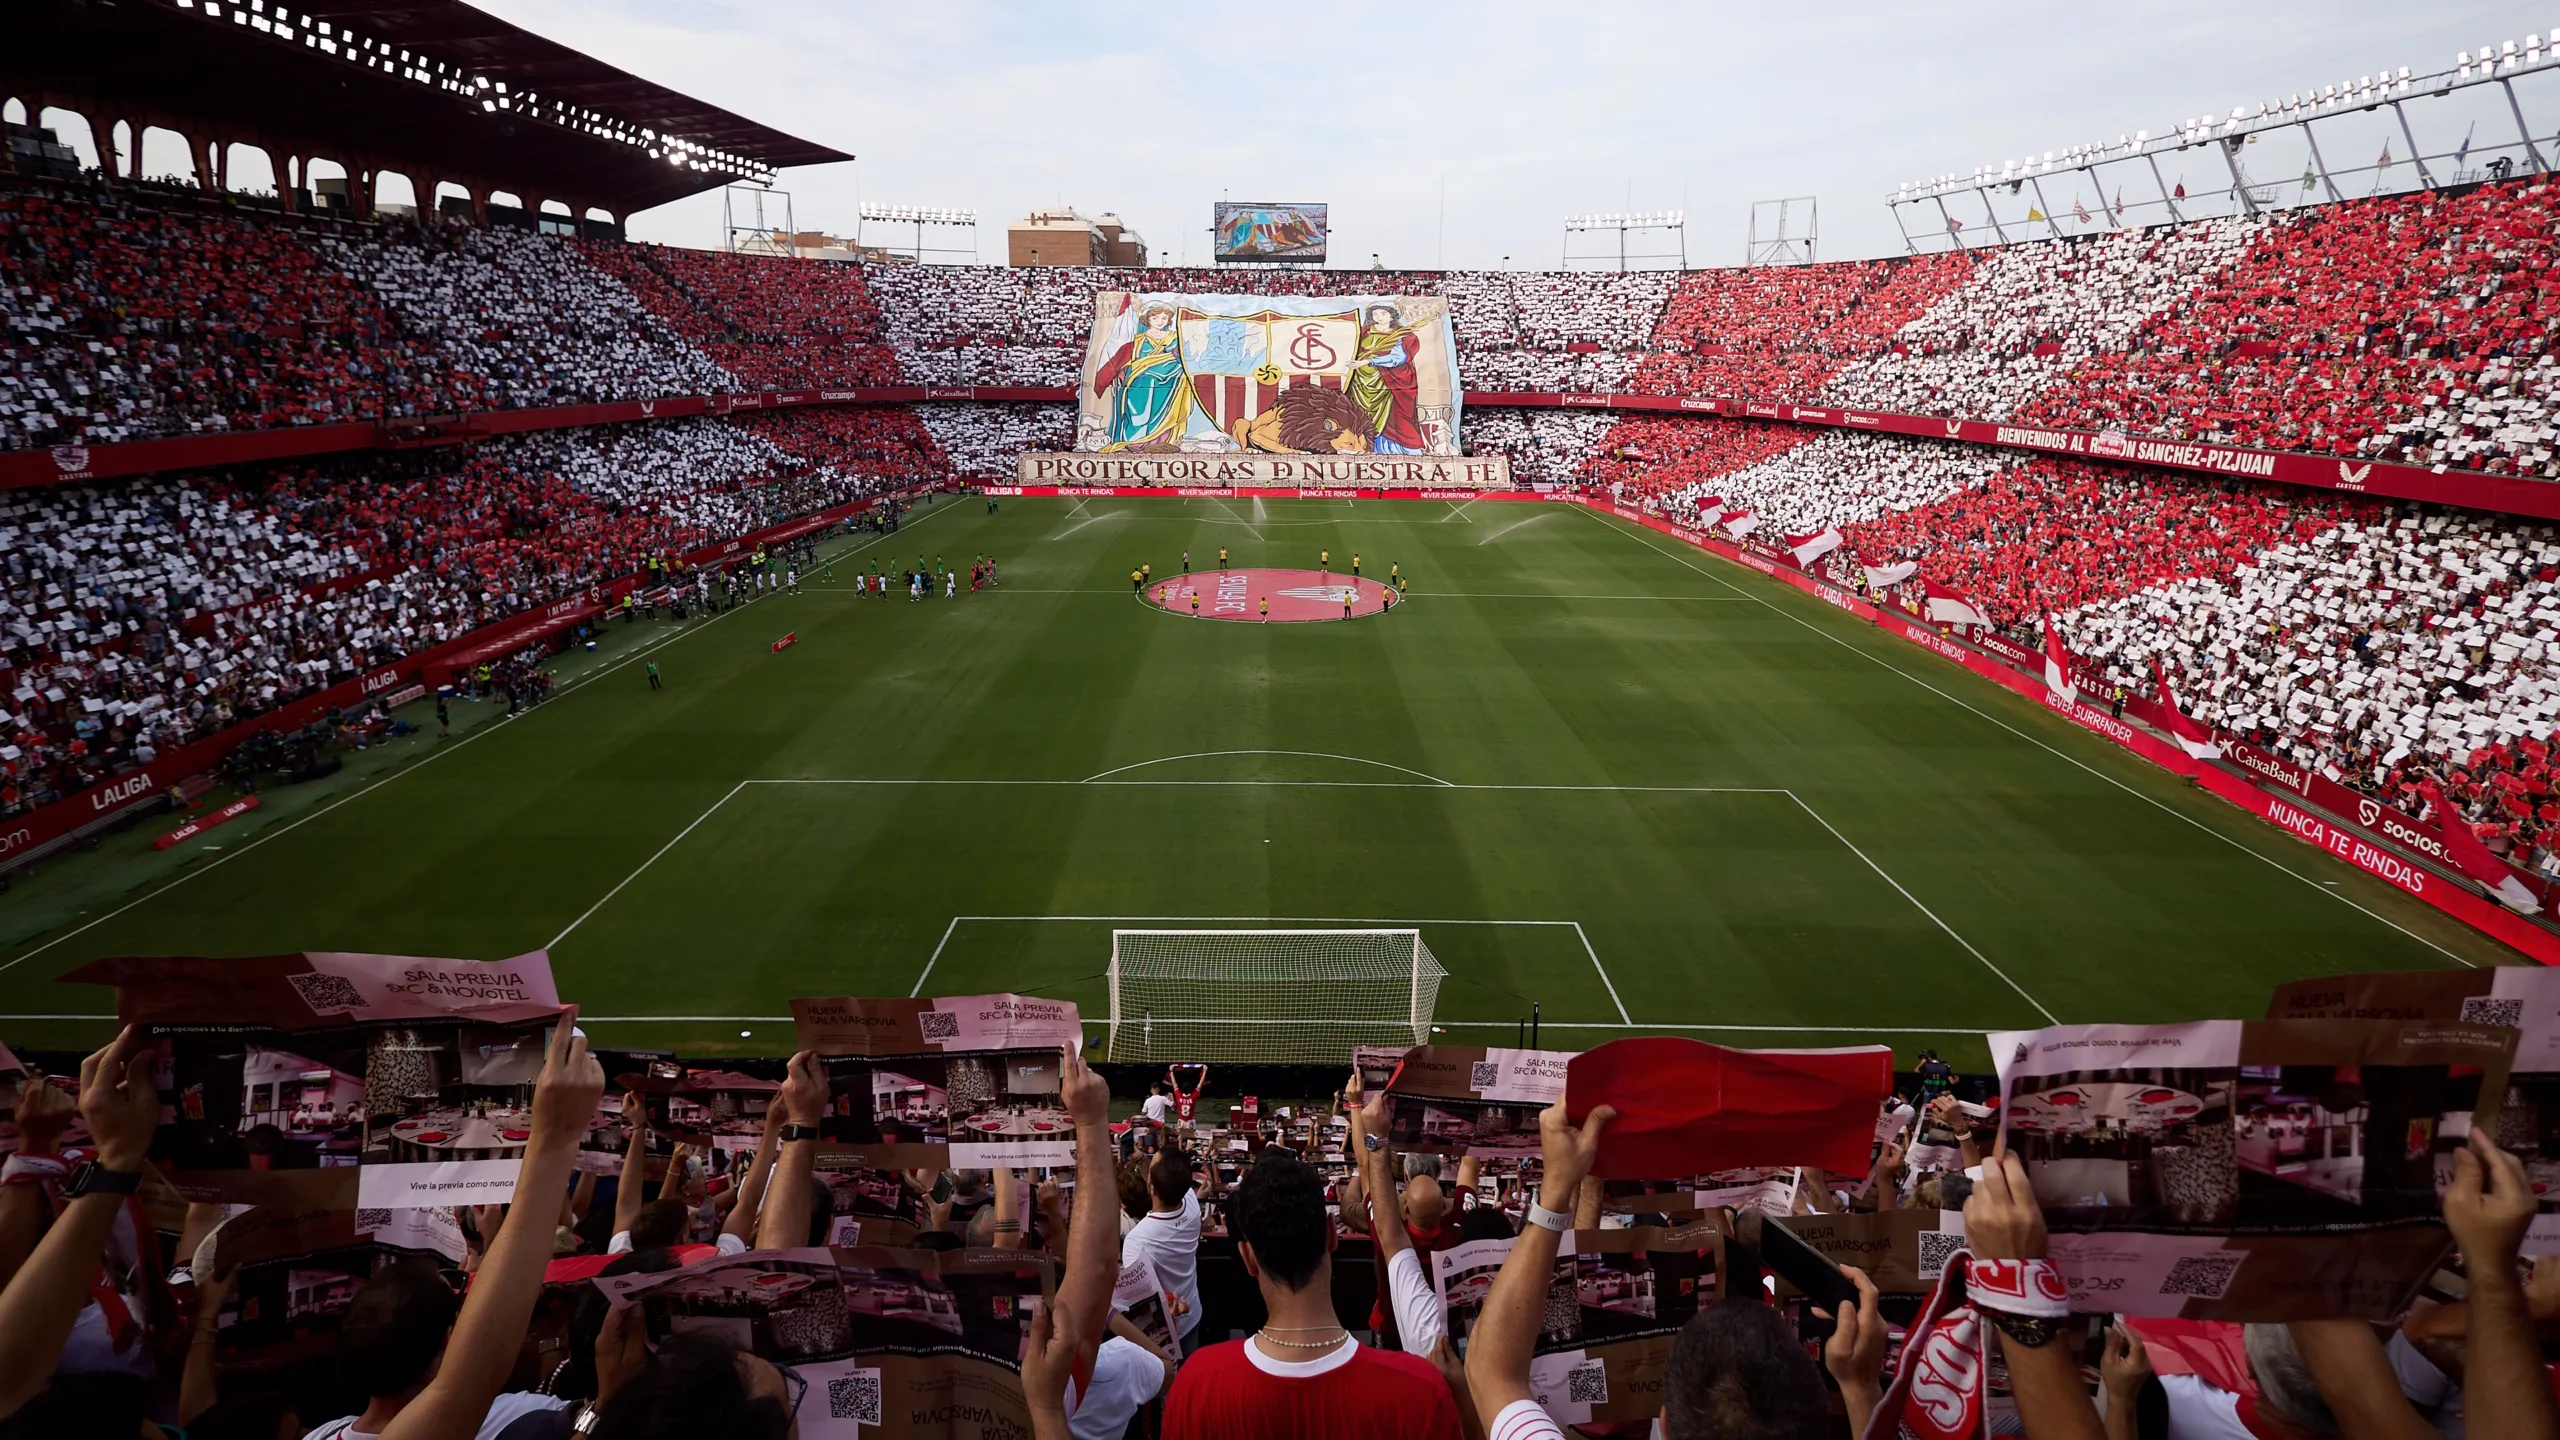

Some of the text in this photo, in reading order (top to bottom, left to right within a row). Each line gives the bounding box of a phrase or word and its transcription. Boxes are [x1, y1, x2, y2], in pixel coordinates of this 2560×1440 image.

[821, 391, 855, 401] Cruzcampo
[1575, 396, 1606, 404] CaixaBank
[1681, 399, 1715, 410] Cruzcampo
[1996, 427, 2066, 450] BIENVENIDOS
[2070, 435, 2084, 452] AL
[2090, 436, 2135, 459] RON
[2138, 442, 2276, 476] SANCHEZ-PIZJUAN
[1034, 458, 1498, 482] PROTECTORAS NUESTRA FE
[985, 488, 1013, 496] LALIGA
[2335, 482, 2365, 491] CASTORE
[1544, 493, 1566, 501] NUNCA
[1755, 545, 1778, 559] socios.com
[1906, 626, 1966, 662] NUNCA TE RINDAS
[1984, 636, 2026, 662] socios.com
[360, 669, 398, 694] LALIGA
[2045, 690, 2133, 743] NEVER SURRENDER
[2235, 747, 2301, 788] CaixaBank
[91, 773, 153, 811] LALIGA
[224, 802, 248, 817] LALIGA
[172, 824, 200, 840] LALIGA
[2268, 801, 2424, 892] NUNCA TE RINDAS
[404, 970, 524, 986] SALA PREVIA
[2288, 991, 2346, 1009] NUEVA
[807, 1006, 846, 1015] NUEVA
[995, 1001, 1063, 1014] SALA PREVIA
[810, 1015, 897, 1027] SALA VARSOVIA
[980, 1012, 1002, 1021] SFC
[153, 1026, 171, 1035] Dos
[173, 1026, 209, 1034] opciones
[2062, 1040, 2090, 1048] nunca
[2092, 1039, 2118, 1047] como
[2120, 1038, 2150, 1047] previa
[2161, 1038, 2181, 1047] Vive
[1416, 1061, 1457, 1071] VARSOVIA
[1526, 1059, 1546, 1067] SALA
[1513, 1067, 1529, 1076] SFC
[1181, 1104, 1191, 1117] 8
[998, 1153, 1014, 1161] previa
[410, 1182, 427, 1190] Vive
[429, 1181, 437, 1189] la
[438, 1181, 464, 1191] previa
[489, 1180, 514, 1188] nunca
[1826, 1238, 1892, 1253] VARSOVIA
[1120, 1262, 1145, 1280] PREVIA
[2086, 1277, 2124, 1290] SFC
[887, 1344, 916, 1353] catering,
[932, 1344, 971, 1356] disposición
[972, 1350, 980, 1358] tu
[987, 1355, 1016, 1368] opciones
[911, 1404, 1028, 1437] SALA VARSOVIA
